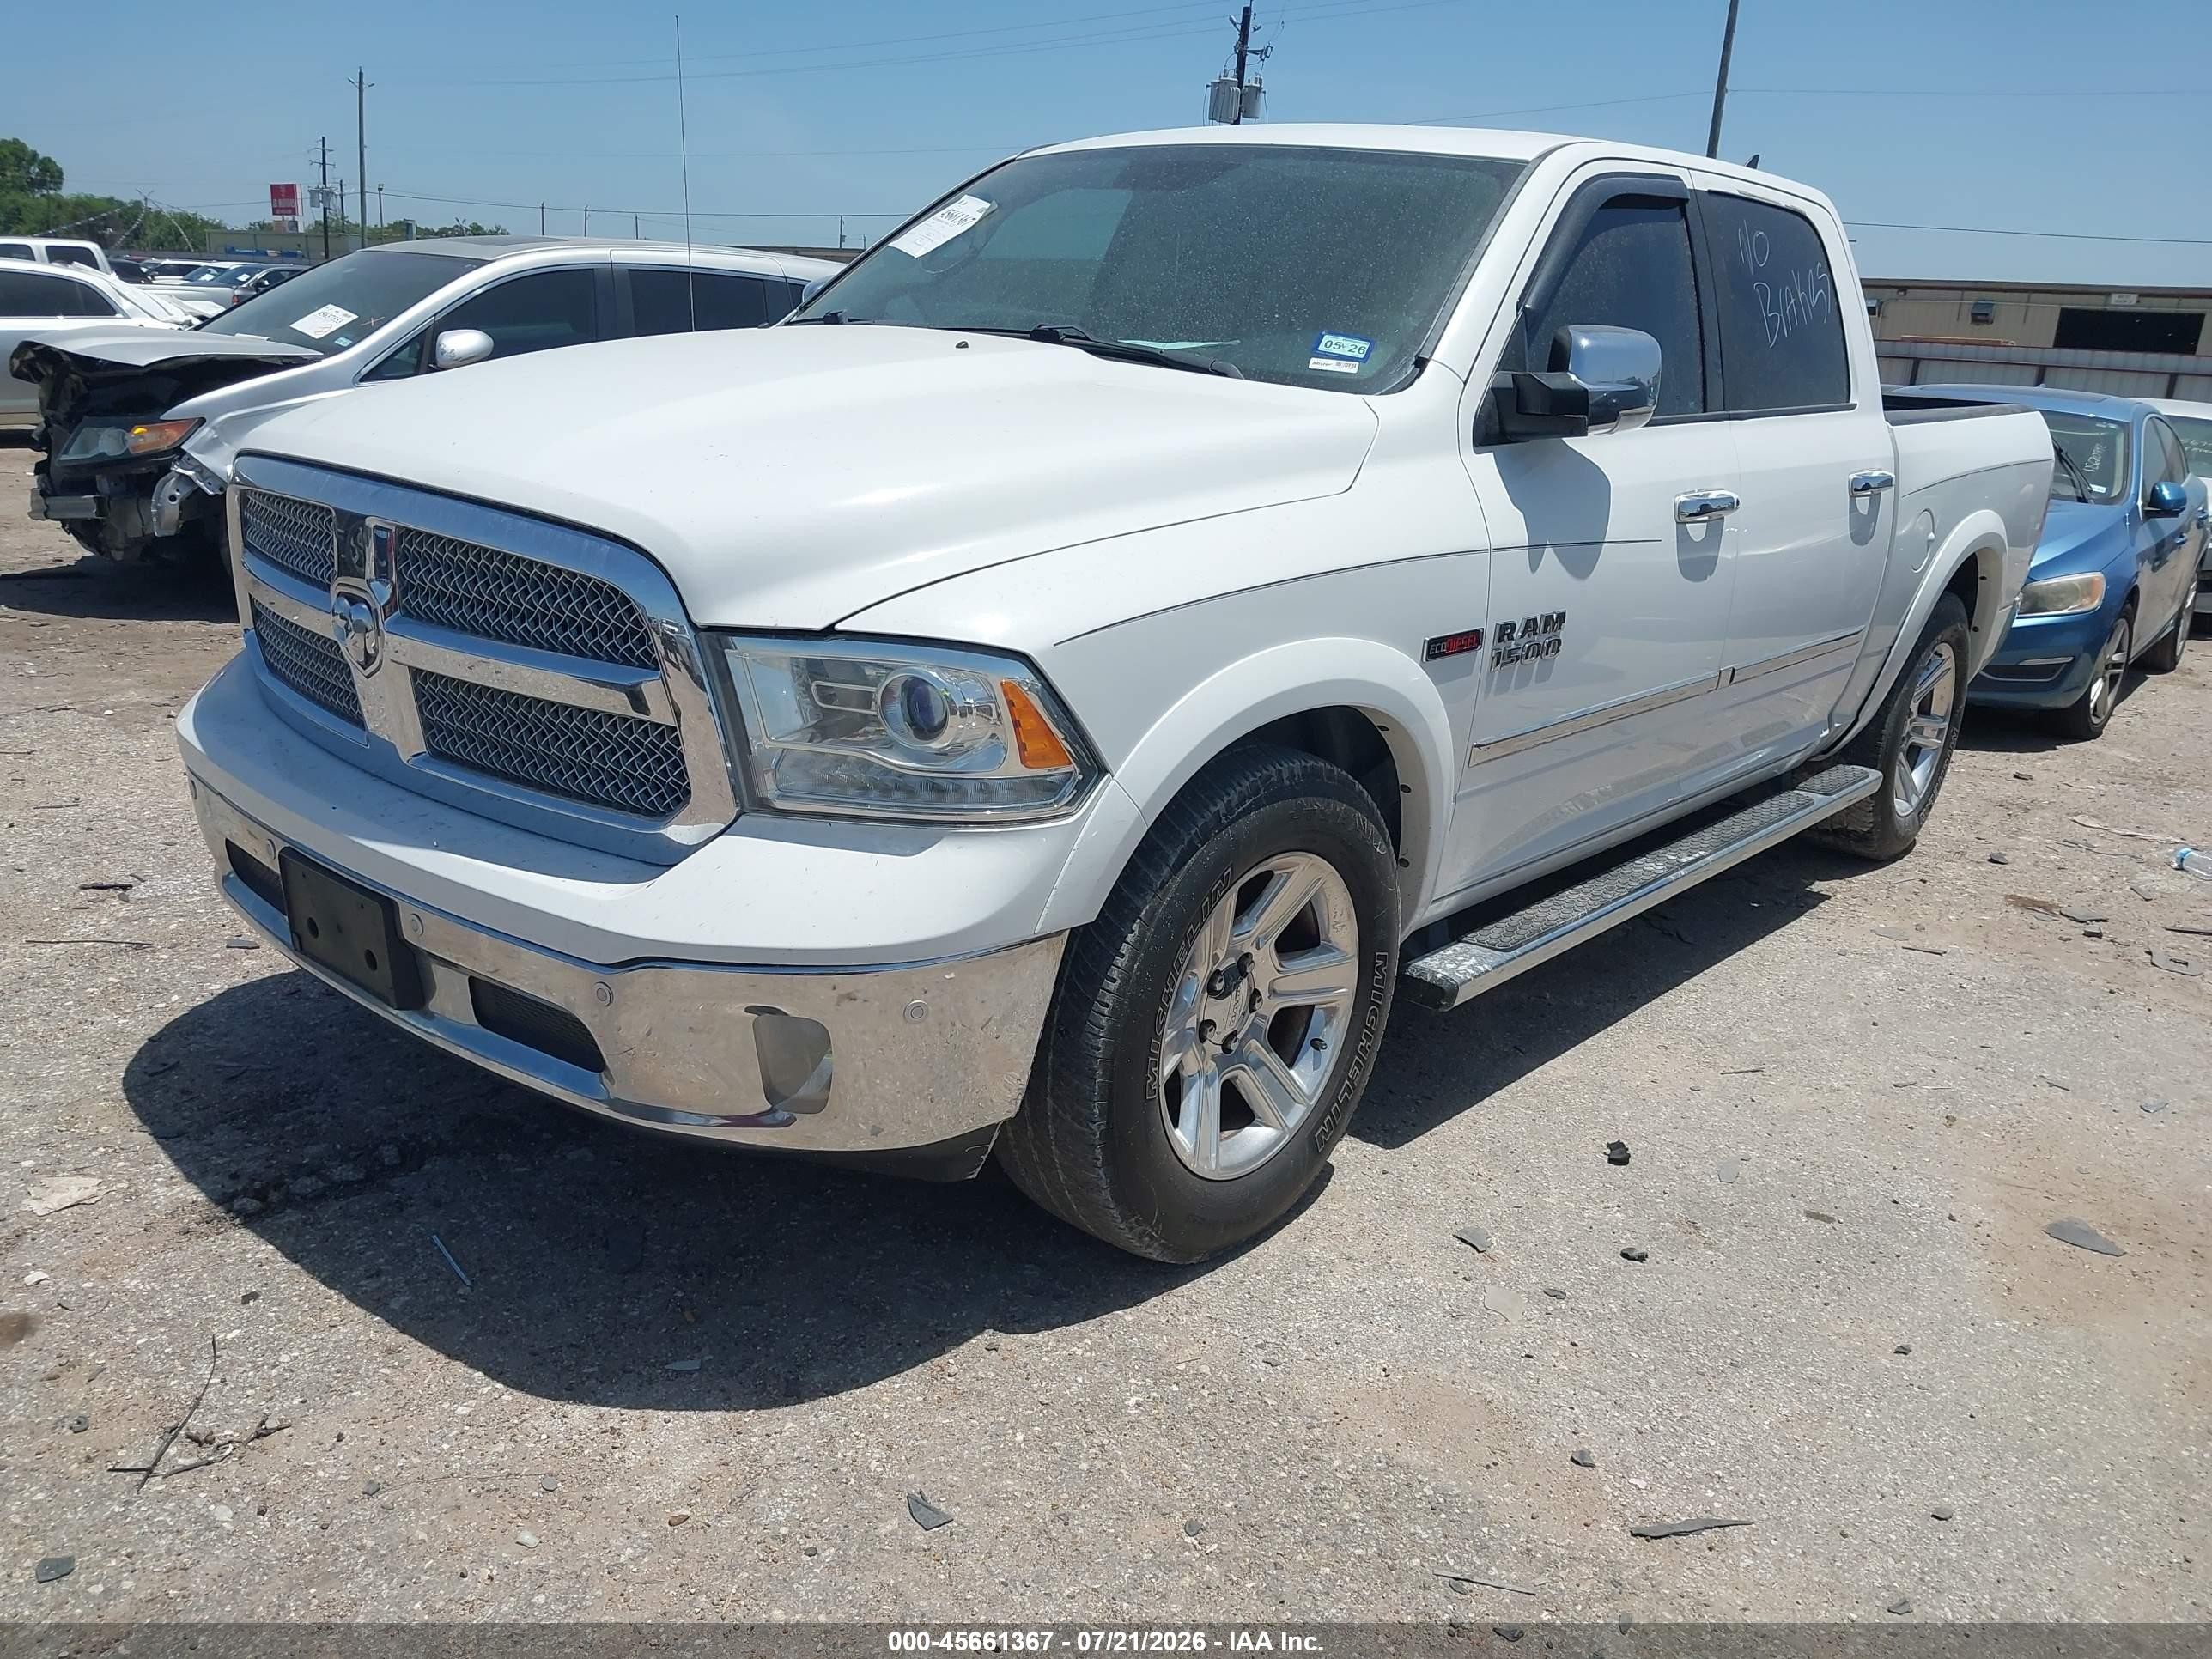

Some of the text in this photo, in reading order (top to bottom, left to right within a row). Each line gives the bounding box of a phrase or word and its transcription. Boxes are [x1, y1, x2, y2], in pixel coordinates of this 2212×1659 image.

[1323, 340, 1367, 355] 05 26
[1492, 609, 1567, 647] RAM
[1490, 636, 1563, 673] 1500
[1146, 867, 1232, 1100] MICHELIN
[1315, 951, 1389, 1153] MICHELIN
